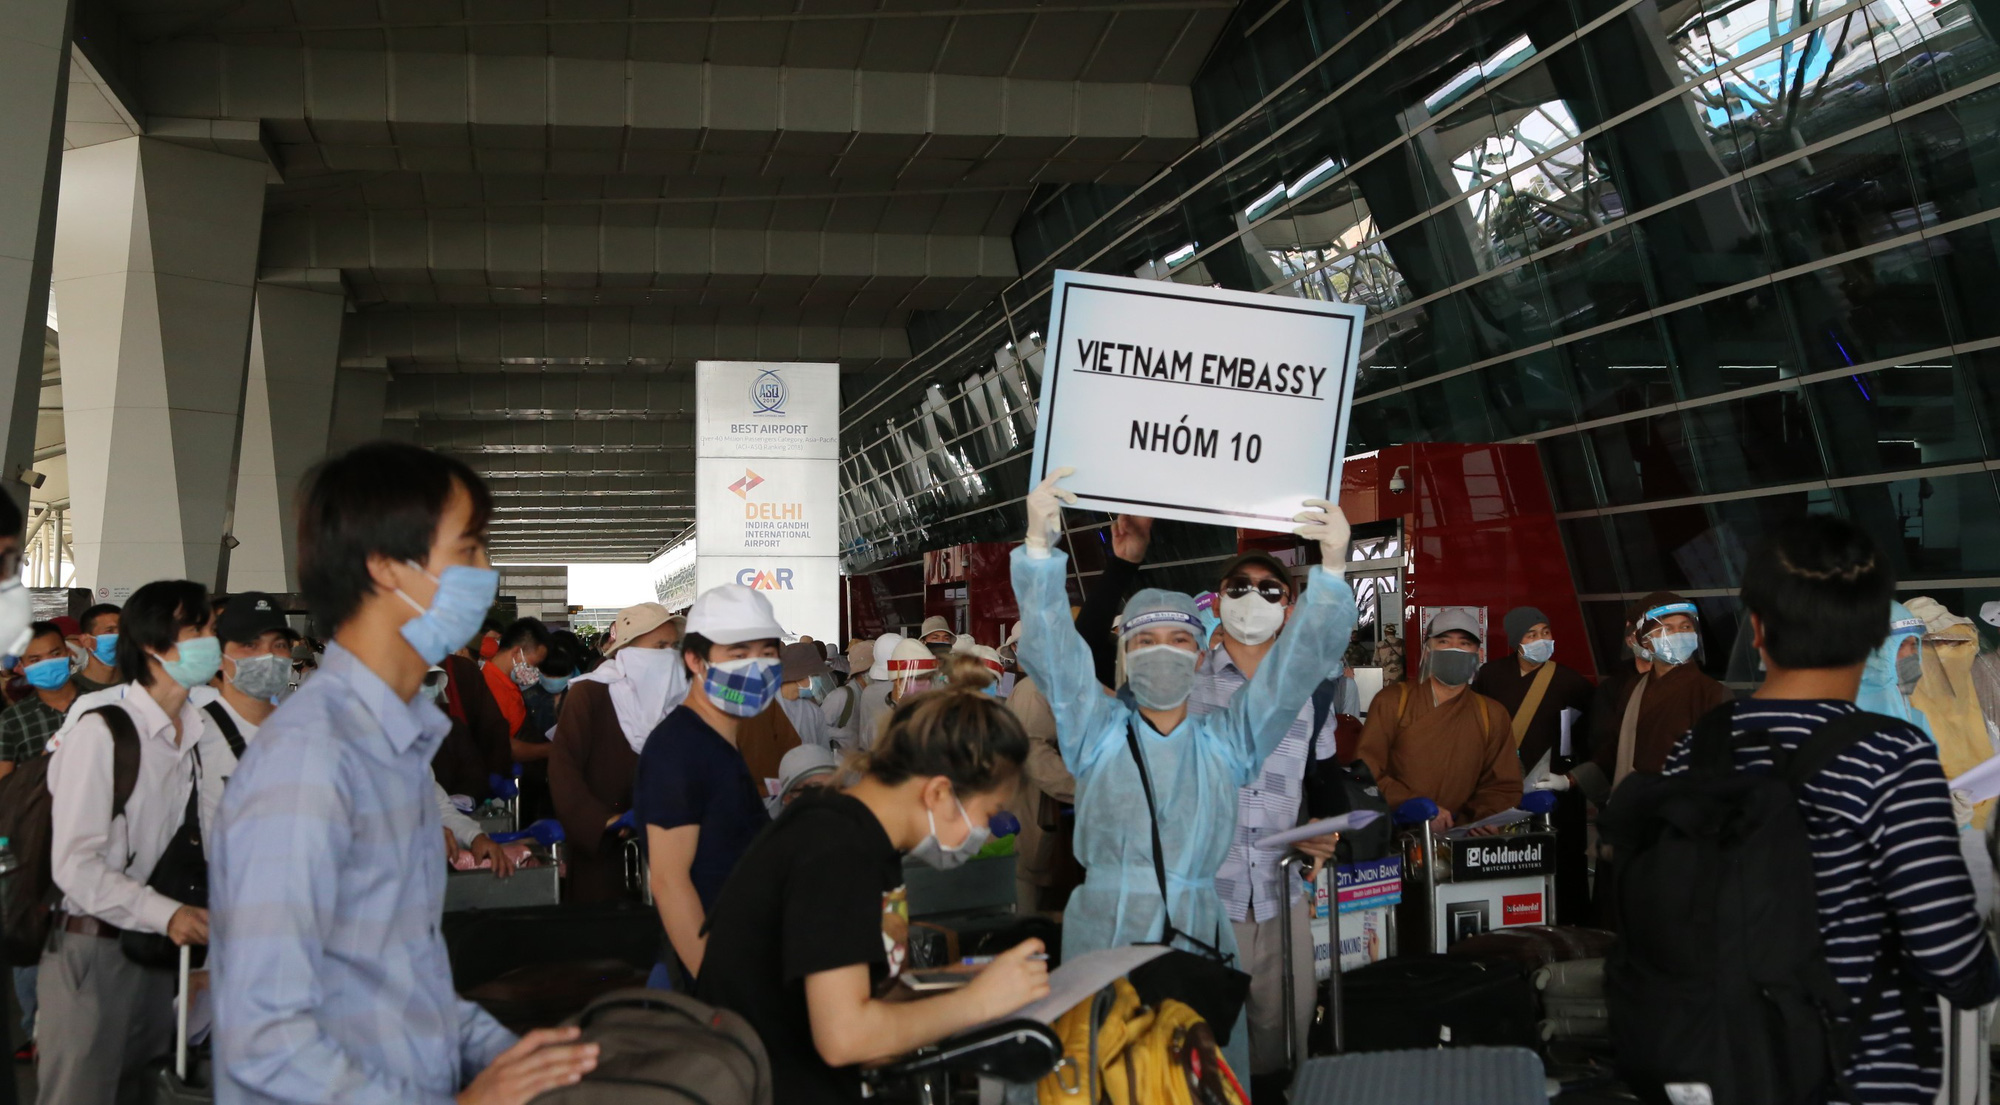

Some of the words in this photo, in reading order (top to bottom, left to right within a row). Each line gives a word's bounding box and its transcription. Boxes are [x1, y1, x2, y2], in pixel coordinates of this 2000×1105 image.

[1077, 339, 1192, 381] VIETNAM
[1200, 354, 1327, 396] EMBASSY
[759, 384, 779, 398] ASQ
[731, 424, 758, 434] BEST
[760, 424, 808, 434] AIRPORT
[1129, 414, 1219, 458] NHÓM
[1230, 432, 1262, 463] 10
[745, 502, 802, 520] DELHI
[745, 521, 775, 529] INDIRA
[777, 521, 809, 530] GANDHI
[745, 530, 811, 539] INTERNATIONAL
[744, 539, 781, 547] AIRPORT
[735, 567, 794, 590] GMR
[1482, 843, 1542, 865] Goldmedal
[1355, 868, 1379, 883] UNION
[1380, 864, 1399, 878] BANK
[1482, 865, 1511, 873] SWITCHES
[1339, 936, 1361, 956] ANKING
